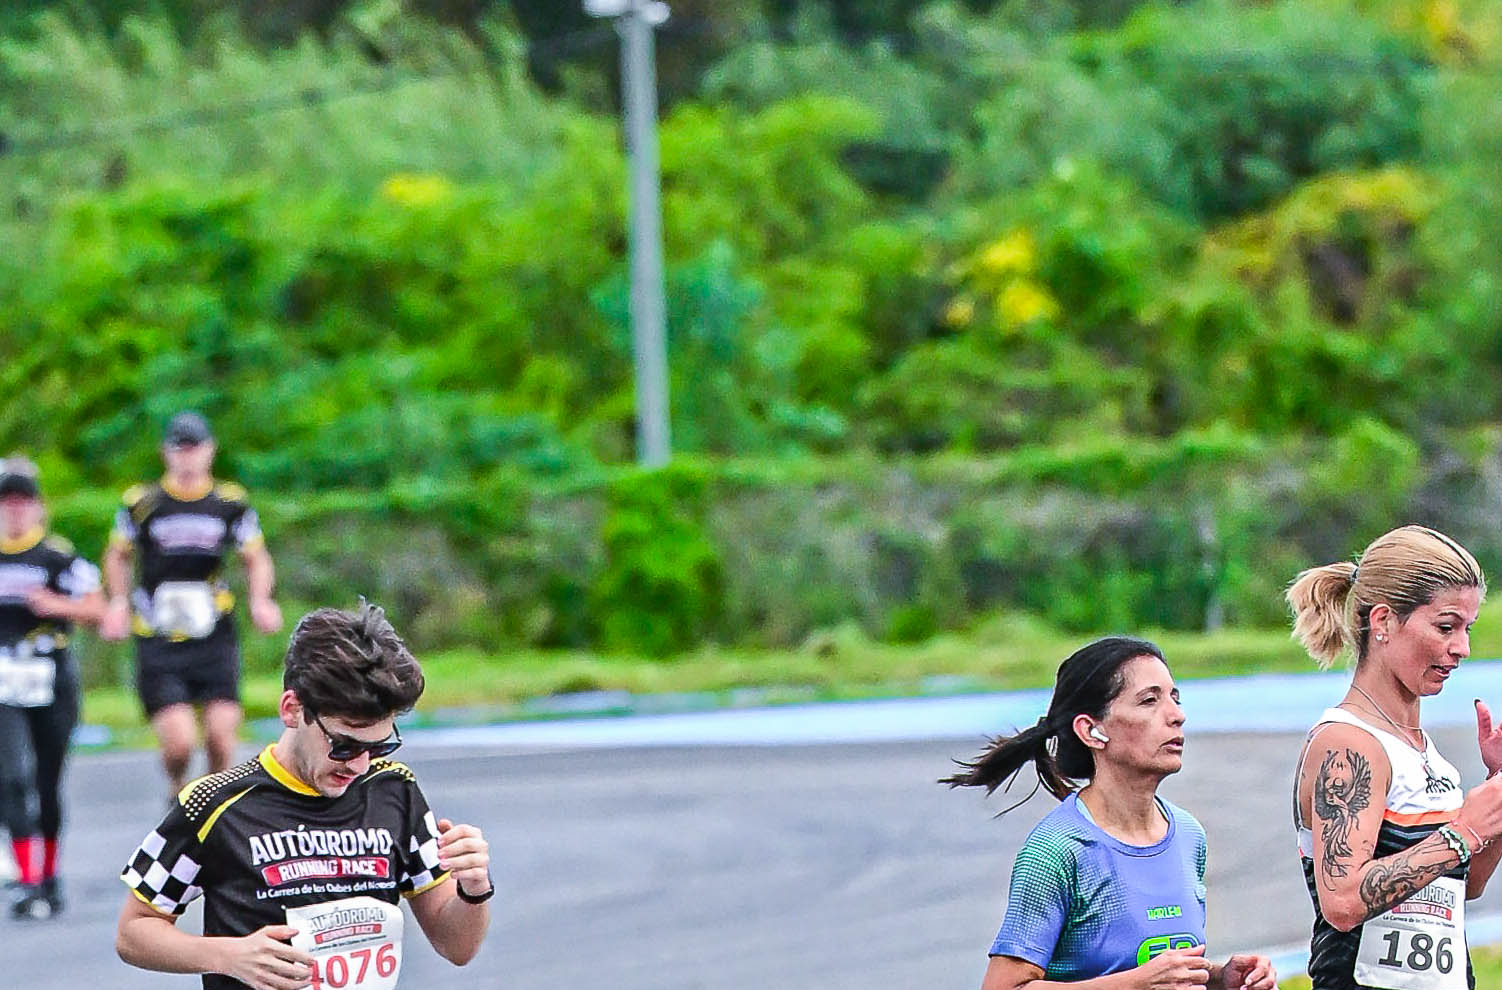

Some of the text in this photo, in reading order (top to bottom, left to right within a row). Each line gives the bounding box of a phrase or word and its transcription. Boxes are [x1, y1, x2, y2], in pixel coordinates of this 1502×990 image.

[249, 824, 393, 865] AUTÓDROMO
[278, 857, 377, 881] RUNNING RACE
[256, 889, 267, 900] La
[1378, 930, 1453, 975] 186
